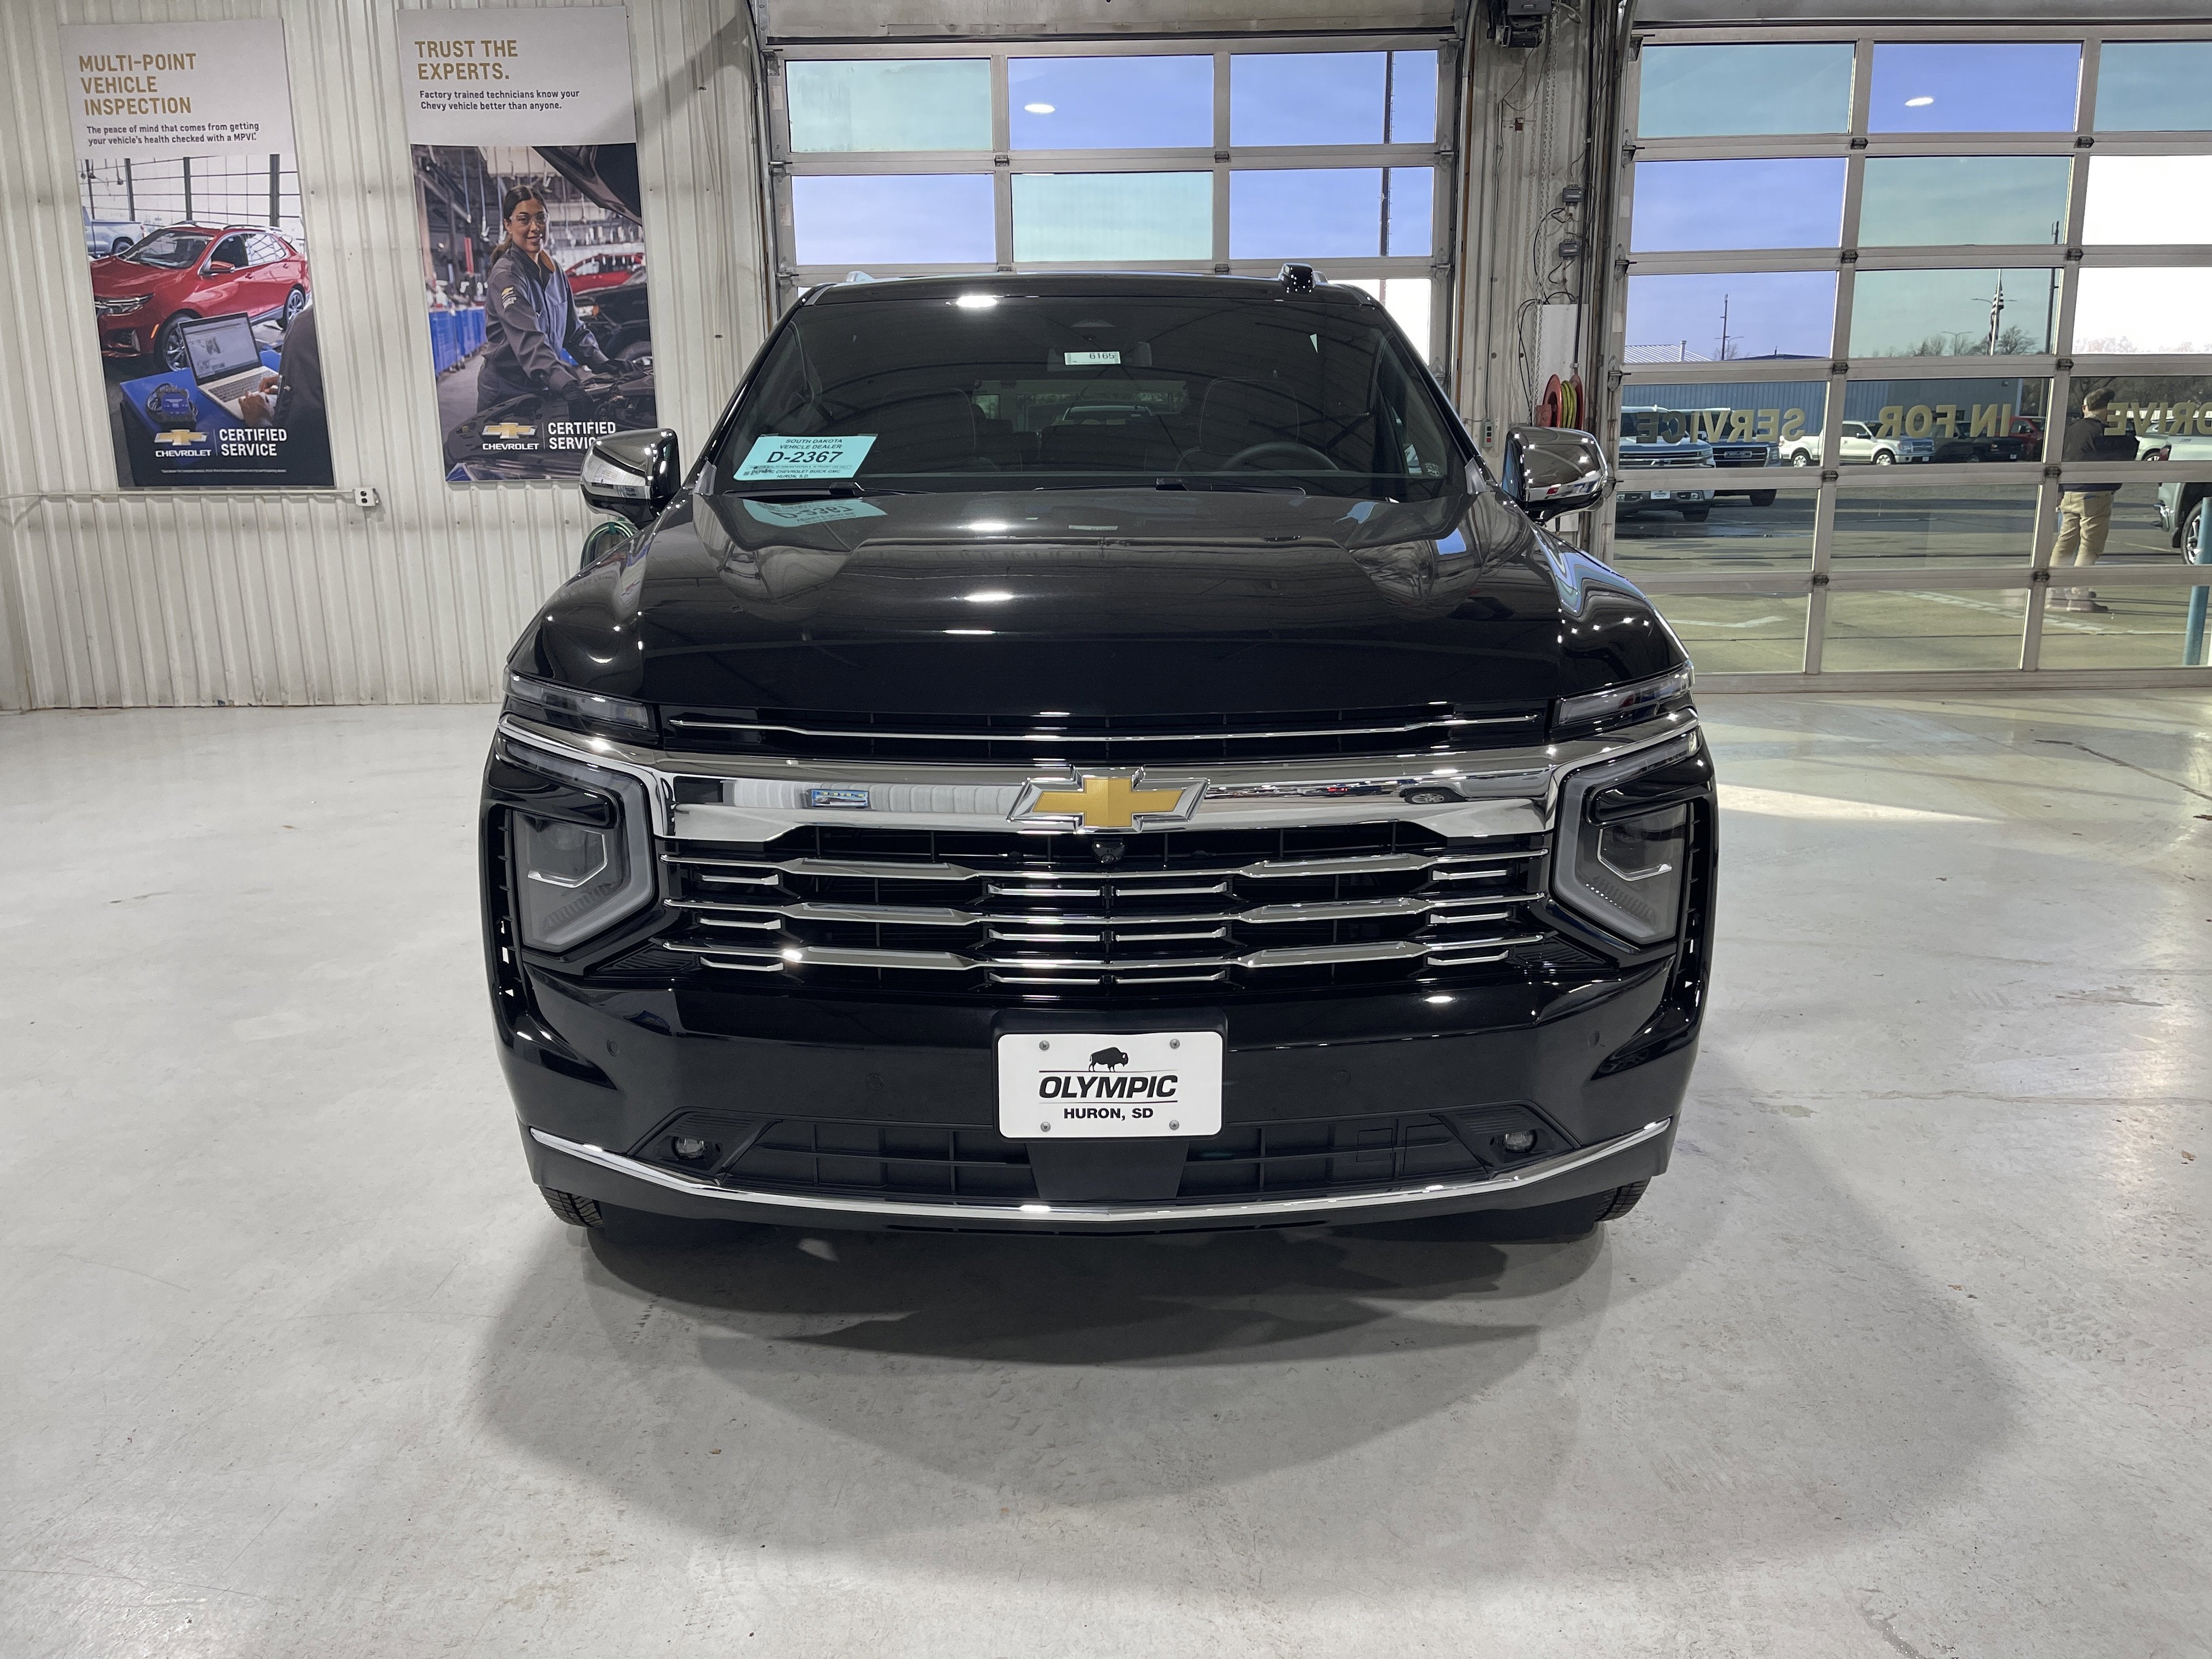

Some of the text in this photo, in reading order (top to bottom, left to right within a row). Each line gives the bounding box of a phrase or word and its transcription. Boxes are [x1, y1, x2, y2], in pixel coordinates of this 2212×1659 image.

[415, 40, 518, 58] TRUST THE
[79, 53, 196, 72] MULTI-POINT
[417, 63, 510, 80] EXPERTS.
[81, 76, 158, 94] VEHICLE
[420, 89, 580, 100] Factory trained technicians know your
[84, 97, 192, 116] INSPECTION
[421, 101, 562, 112] Chevy vehicle better than anyone.
[87, 122, 259, 136] The peace of mind that comes from getting
[88, 138, 106, 147] your
[108, 136, 142, 144] vehicle's
[144, 135, 170, 144] health
[172, 134, 205, 143] checked
[206, 133, 225, 142] with
[219, 428, 287, 442] CERTIFIED
[548, 421, 616, 435] CERTIFIED
[155, 449, 212, 458] CHEVROLET
[221, 443, 278, 457] SERVICE
[766, 451, 844, 464] D-2367
[1039, 1075, 1178, 1098] OLYMPIC
[1064, 1108, 1154, 1120] HURON, SD
